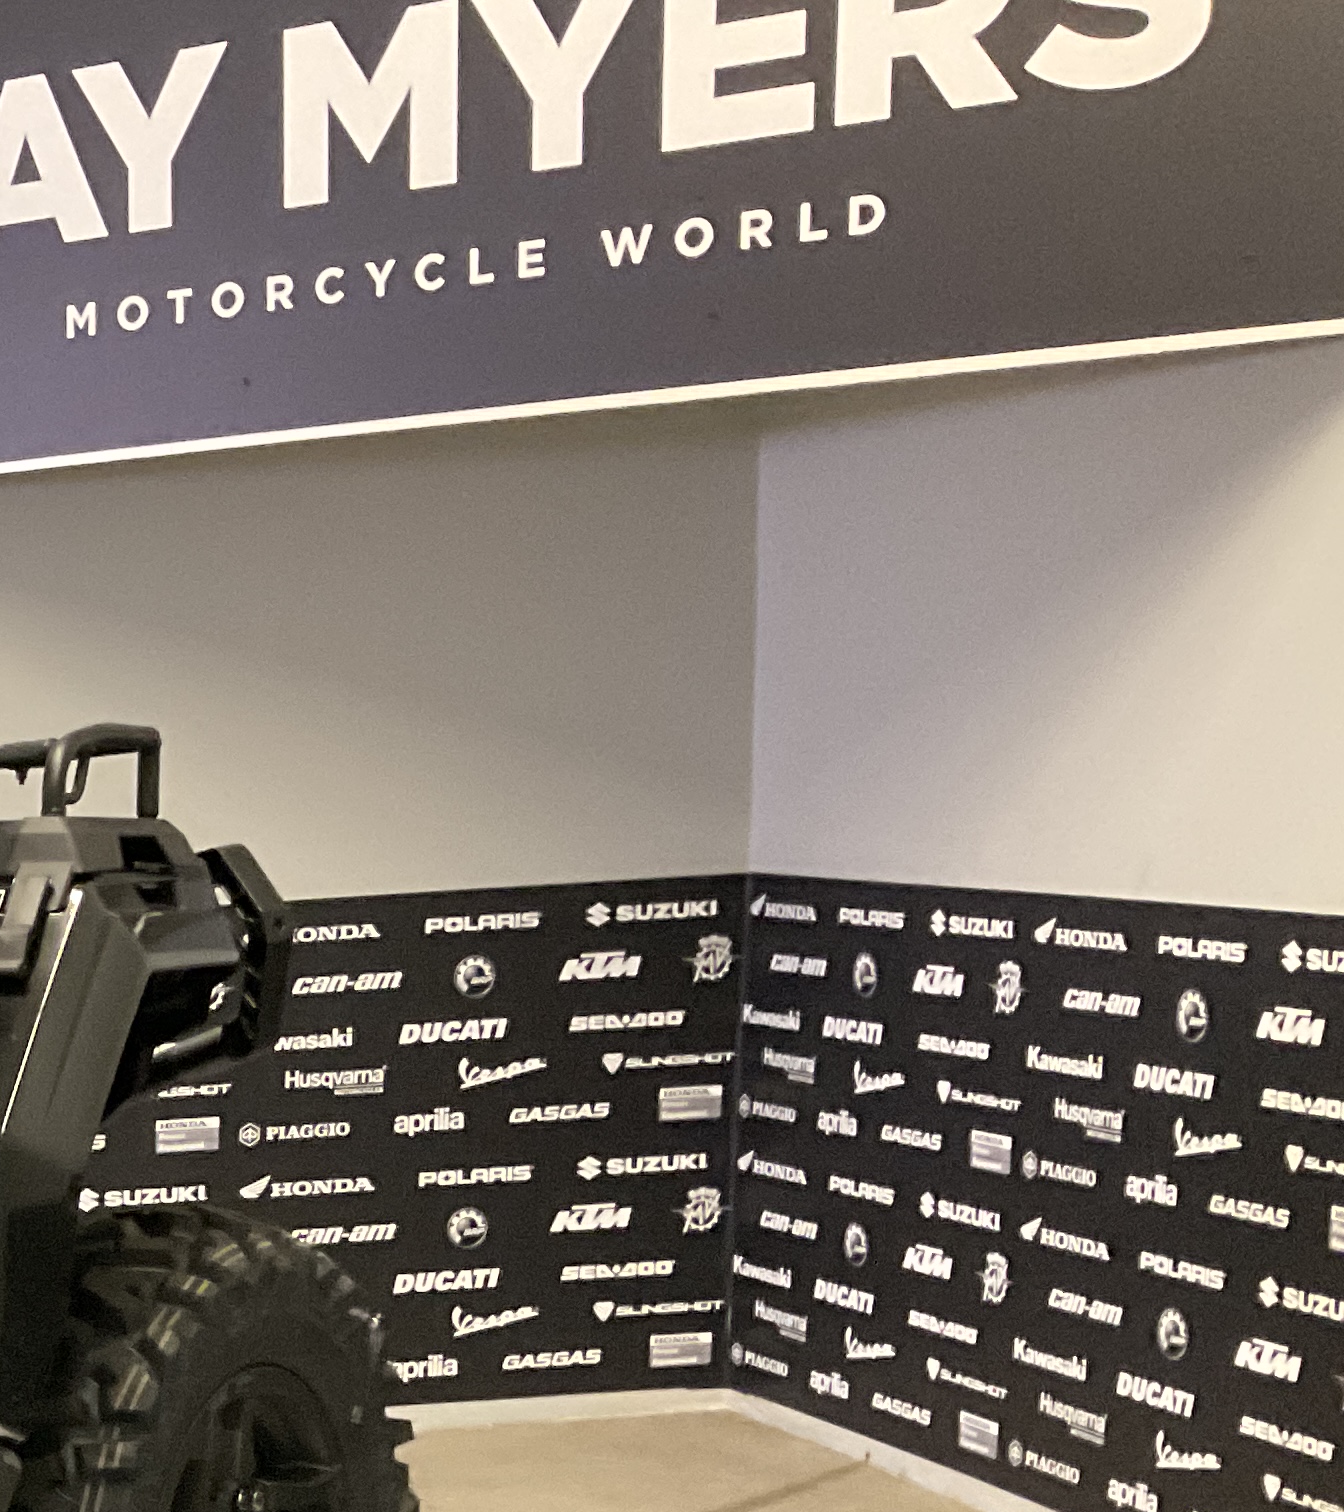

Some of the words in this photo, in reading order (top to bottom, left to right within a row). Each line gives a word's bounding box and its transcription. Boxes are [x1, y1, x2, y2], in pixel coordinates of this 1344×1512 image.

[64, 238, 548, 340] MOTORCYCLE
[600, 193, 888, 270] WORLD
[425, 912, 540, 934] POLARIS
[616, 900, 717, 921] SUZUKI
[764, 903, 816, 921] HONDA
[839, 908, 905, 929] POLARIS
[293, 923, 381, 943] ONDA
[949, 916, 1013, 939] SUZUKI
[1055, 928, 1127, 951] HONDA
[1158, 936, 1247, 962] POLARIS
[559, 951, 641, 981] KTM
[770, 954, 827, 976] can-am
[292, 971, 402, 994] can-am
[912, 965, 964, 997] KTM
[1063, 988, 1140, 1016] can-am
[399, 1018, 507, 1044] DUCATI
[742, 1004, 800, 1031] Kawasaki
[822, 1016, 883, 1045] DUCATI
[1256, 1006, 1325, 1046] KTM
[274, 1026, 354, 1051] wasaki
[1027, 1045, 1103, 1079] Kawasaki
[284, 1063, 386, 1092] Husqvarna
[1133, 1063, 1214, 1099] DUCATI
[394, 1107, 464, 1136] aprilia
[509, 1102, 610, 1123] GASGAS
[752, 1101, 796, 1122] PIAGGIO
[817, 1110, 857, 1136] aprilia
[1053, 1095, 1125, 1132] Husqvarna
[266, 1122, 350, 1140] PIAGGIO
[881, 1125, 942, 1151] GASGAS
[418, 1165, 533, 1187] POLARIS
[606, 1153, 707, 1175] SUZUKI
[753, 1159, 807, 1185] HONDA
[1040, 1160, 1096, 1187] PIAGGIO
[104, 1185, 208, 1207] SUZUKI
[270, 1178, 375, 1197] HONDA
[829, 1175, 895, 1205] POLARIS
[1125, 1175, 1177, 1206] aprilia
[550, 1203, 632, 1232] KTM
[760, 1210, 818, 1240] can-am
[938, 1200, 1000, 1231] SUZUKI
[1209, 1195, 1290, 1228] GASGAS
[1040, 1228, 1110, 1261] HONDA
[733, 1255, 791, 1288] Kawasaki
[902, 1244, 952, 1279] KTM
[1139, 1251, 1225, 1290] POLARIS
[393, 1268, 500, 1294] DUCATI
[814, 1279, 874, 1315] DUCATI
[1048, 1288, 1123, 1326] can-am
[1281, 1284, 1344, 1322] SUZU
[502, 1349, 601, 1370] GASGAS
[745, 1351, 788, 1376] PIAGGIO
[1013, 1338, 1087, 1381] Kawasaki
[1234, 1338, 1301, 1382] KTM
[810, 1371, 849, 1399] aprilia
[1116, 1372, 1194, 1417] DUCATI
[872, 1393, 931, 1425] GASGAS
[1039, 1391, 1107, 1435] Husqvarna
[1025, 1450, 1079, 1484] PIAGGIO
